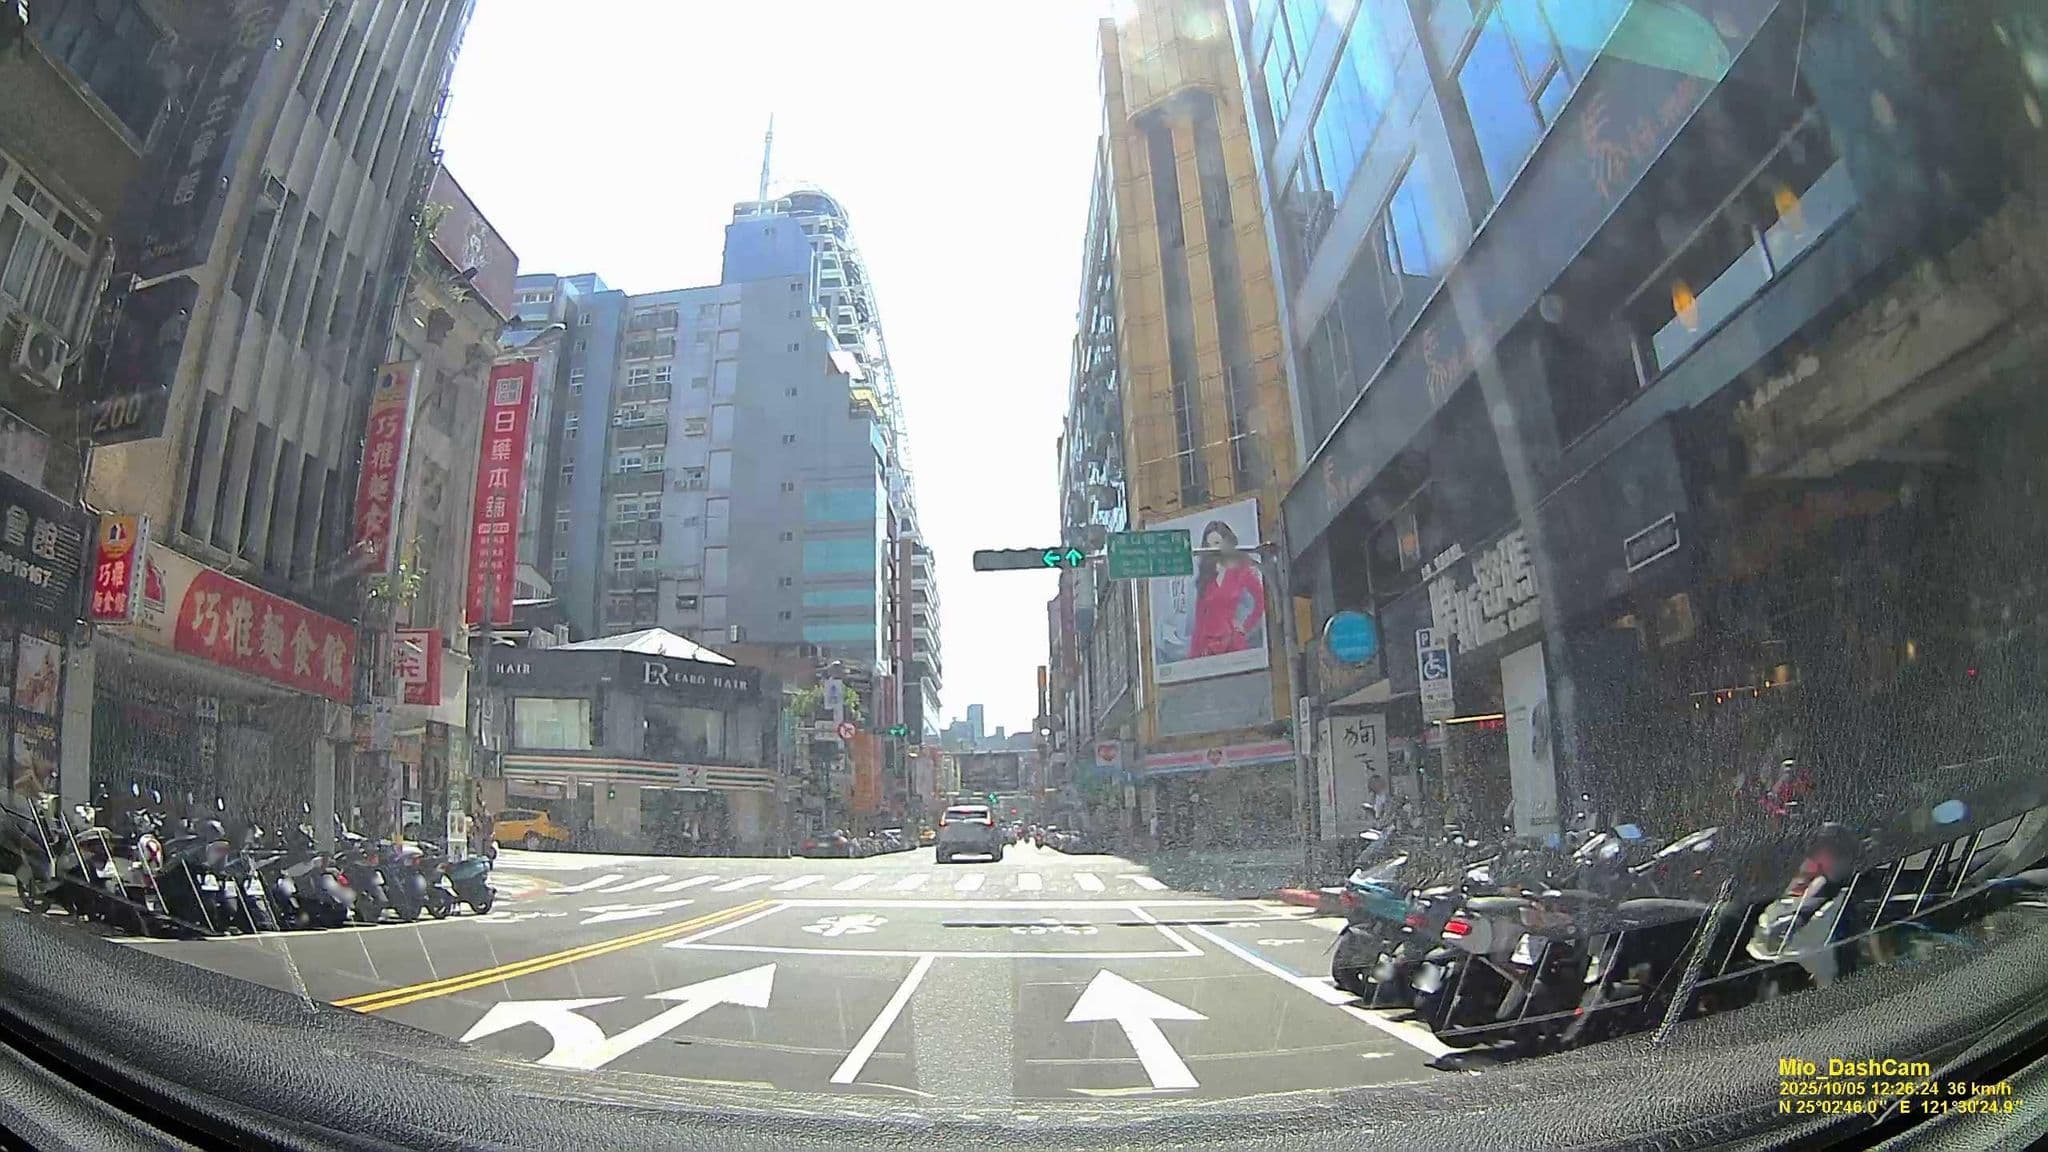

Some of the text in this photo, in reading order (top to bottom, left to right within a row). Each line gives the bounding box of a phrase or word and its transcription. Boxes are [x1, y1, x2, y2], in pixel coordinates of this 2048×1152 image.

[191, 591, 347, 690] 巧雅麵食館
[496, 663, 532, 675] HAIR
[713, 677, 748, 691] HAIR
